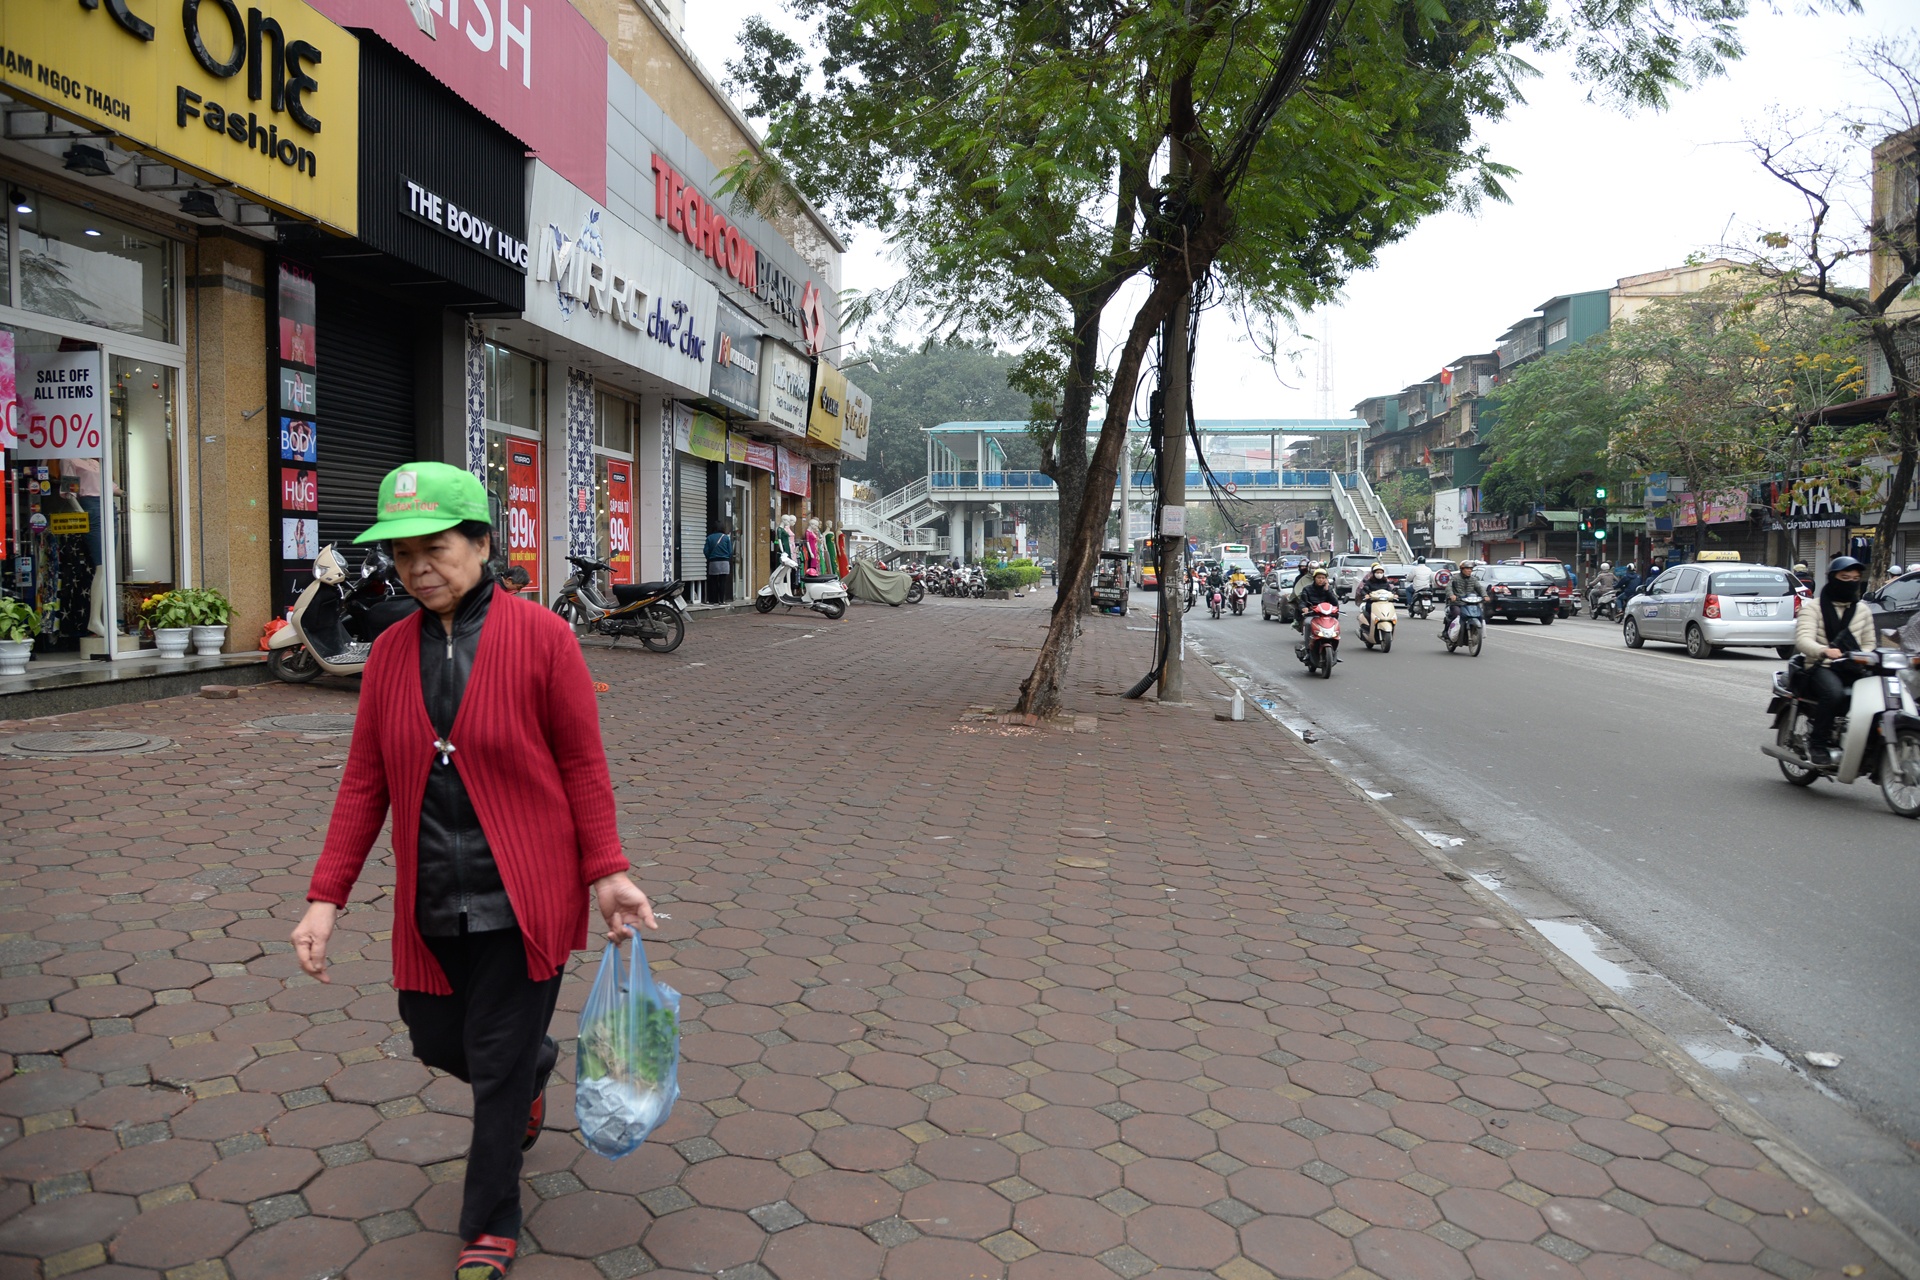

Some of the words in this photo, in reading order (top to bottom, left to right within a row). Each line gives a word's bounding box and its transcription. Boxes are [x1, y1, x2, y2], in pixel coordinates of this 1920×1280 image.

[38, 63, 82, 100] NGỌC
[84, 85, 131, 123] THẠCH
[176, 85, 317, 177] Fashion
[407, 180, 442, 226] THE
[447, 202, 494, 250] BODY
[498, 231, 529, 269] HUG
[37, 369, 66, 384] SALE
[69, 368, 90, 383] OFF
[34, 386, 55, 400] ALL
[58, 385, 94, 399] ITEMS
[284, 379, 312, 405] THE
[17, 413, 100, 449] -50%
[281, 430, 316, 454] BODY
[285, 480, 315, 503] HUG
[509, 507, 537, 549] 99K
